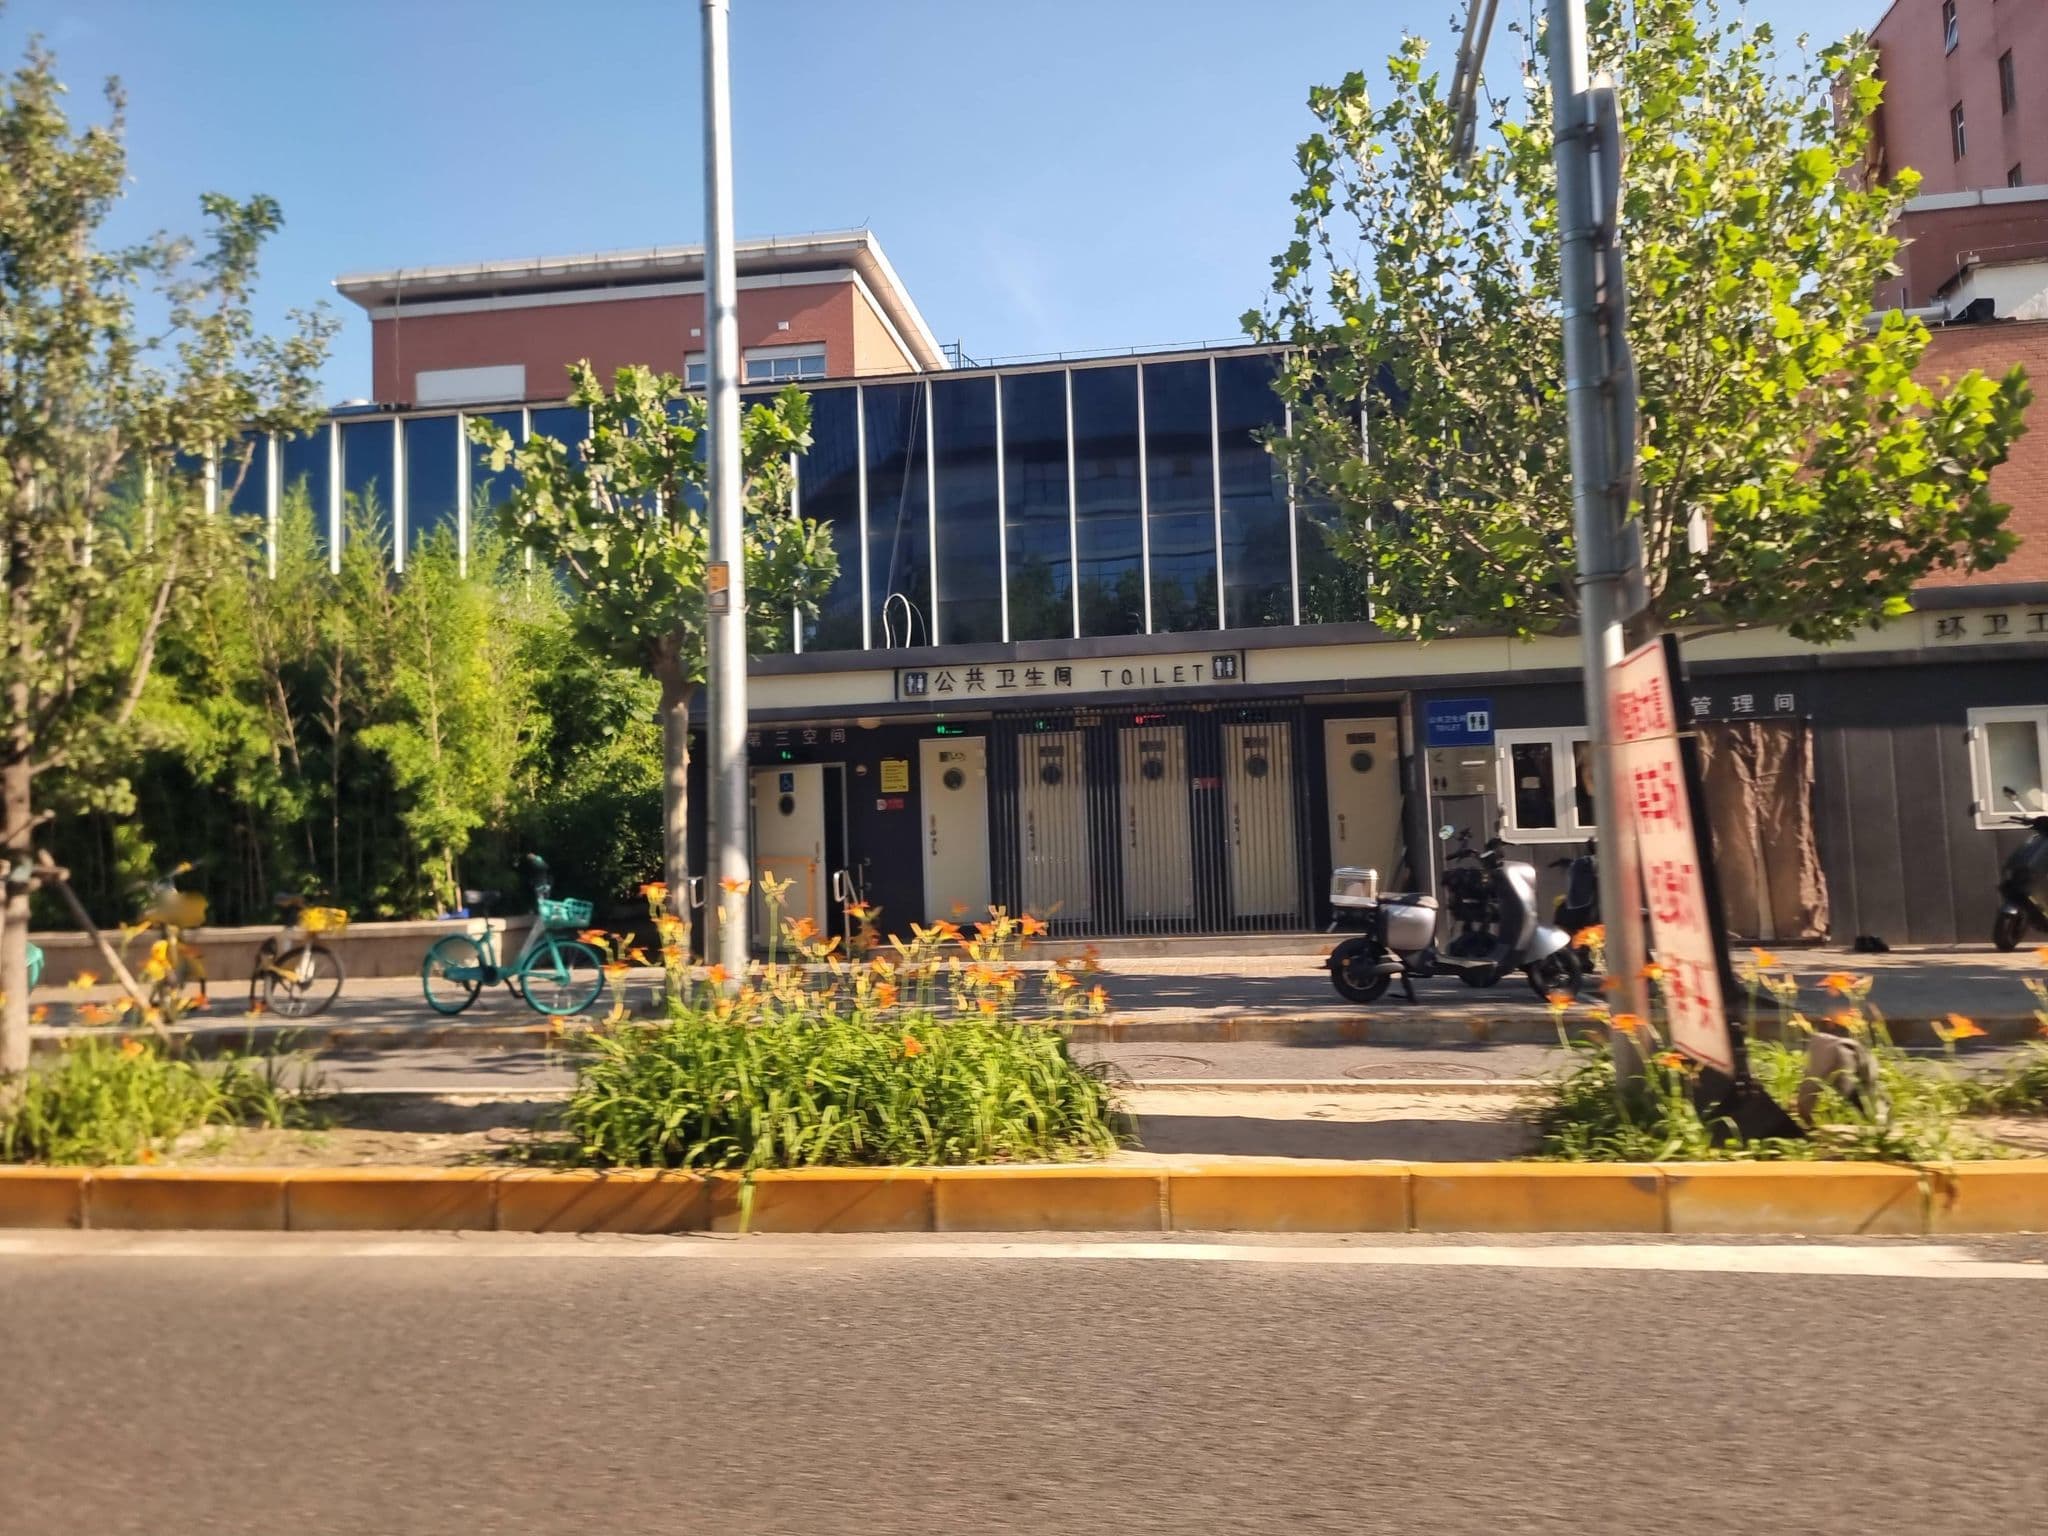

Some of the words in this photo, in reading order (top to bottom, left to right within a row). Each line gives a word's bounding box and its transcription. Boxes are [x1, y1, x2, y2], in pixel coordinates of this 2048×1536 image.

[1935, 612, 2048, 640] 环卫工
[934, 665, 1074, 694] 公共卫生间
[1101, 664, 1205, 688] TOILET
[1690, 693, 1795, 716] 管理间
